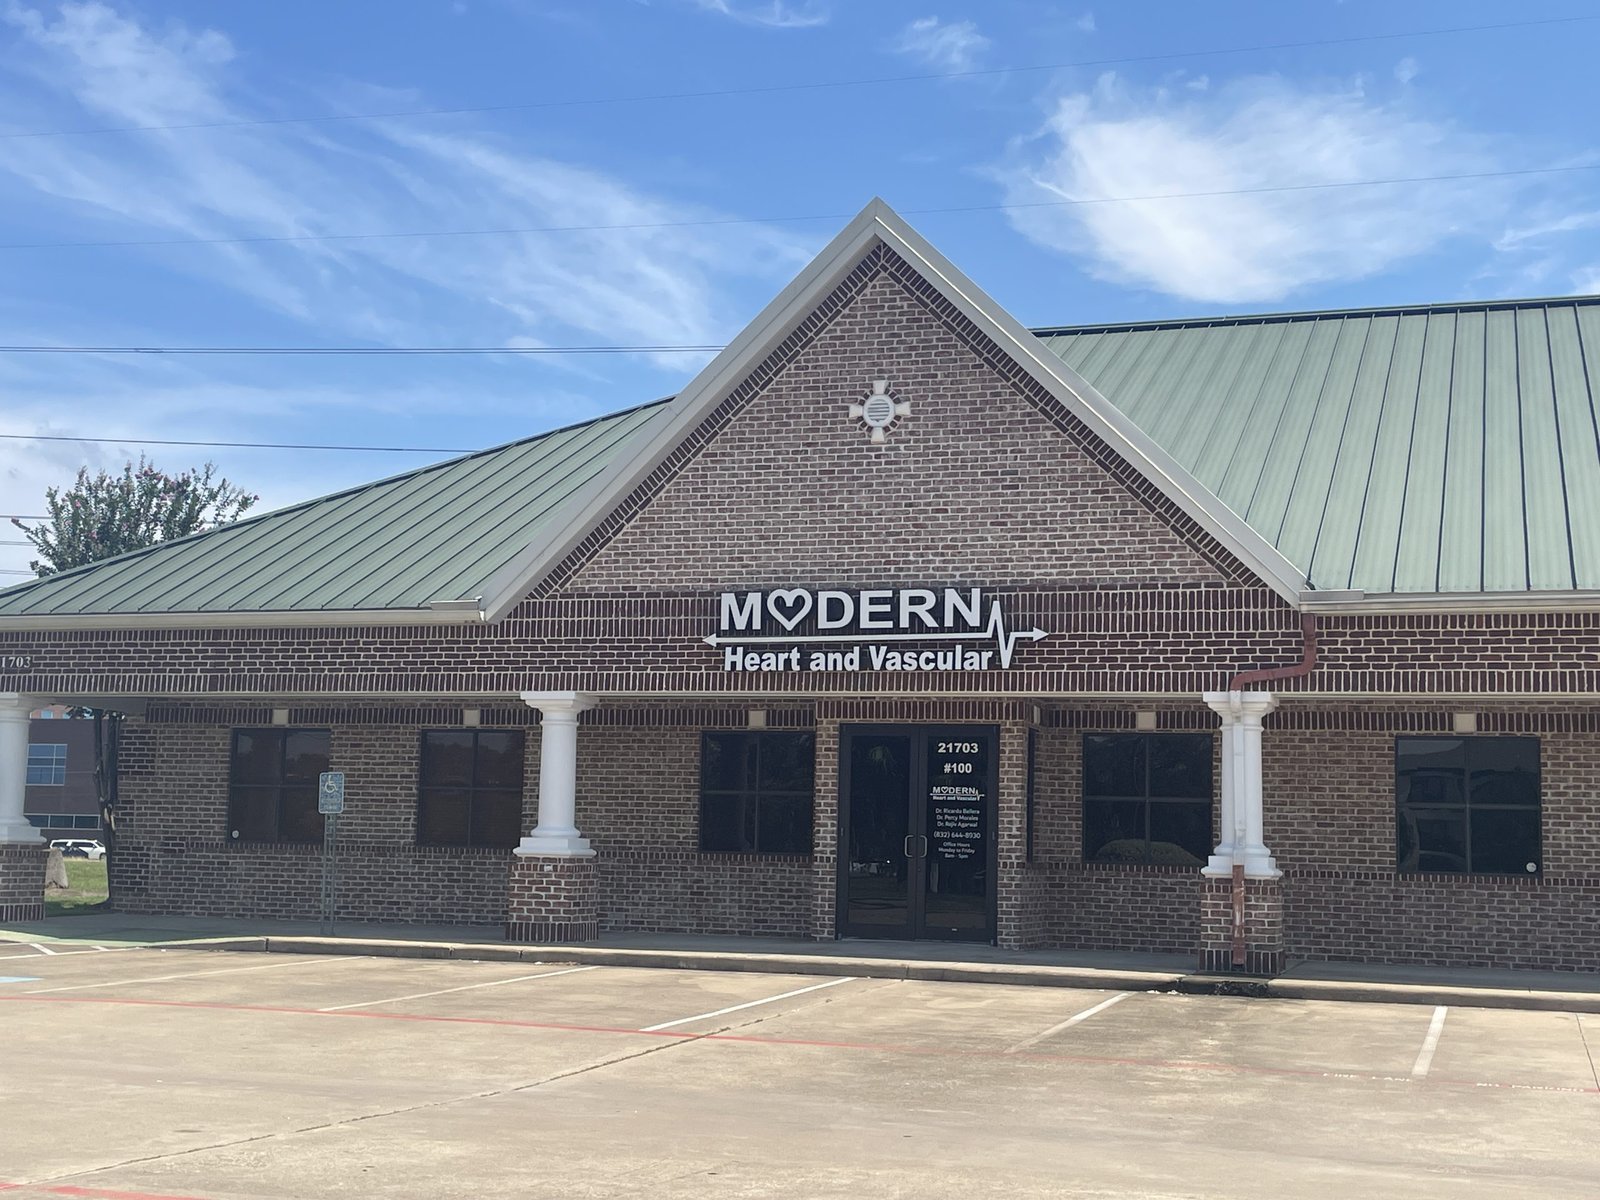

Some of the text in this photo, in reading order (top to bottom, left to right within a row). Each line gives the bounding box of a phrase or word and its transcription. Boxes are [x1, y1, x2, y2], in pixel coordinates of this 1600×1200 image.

[725, 644, 993, 671] Heart and Vascular
[937, 742, 979, 754] 21703
[943, 762, 972, 774] #100
[933, 830, 951, 839] (832)
